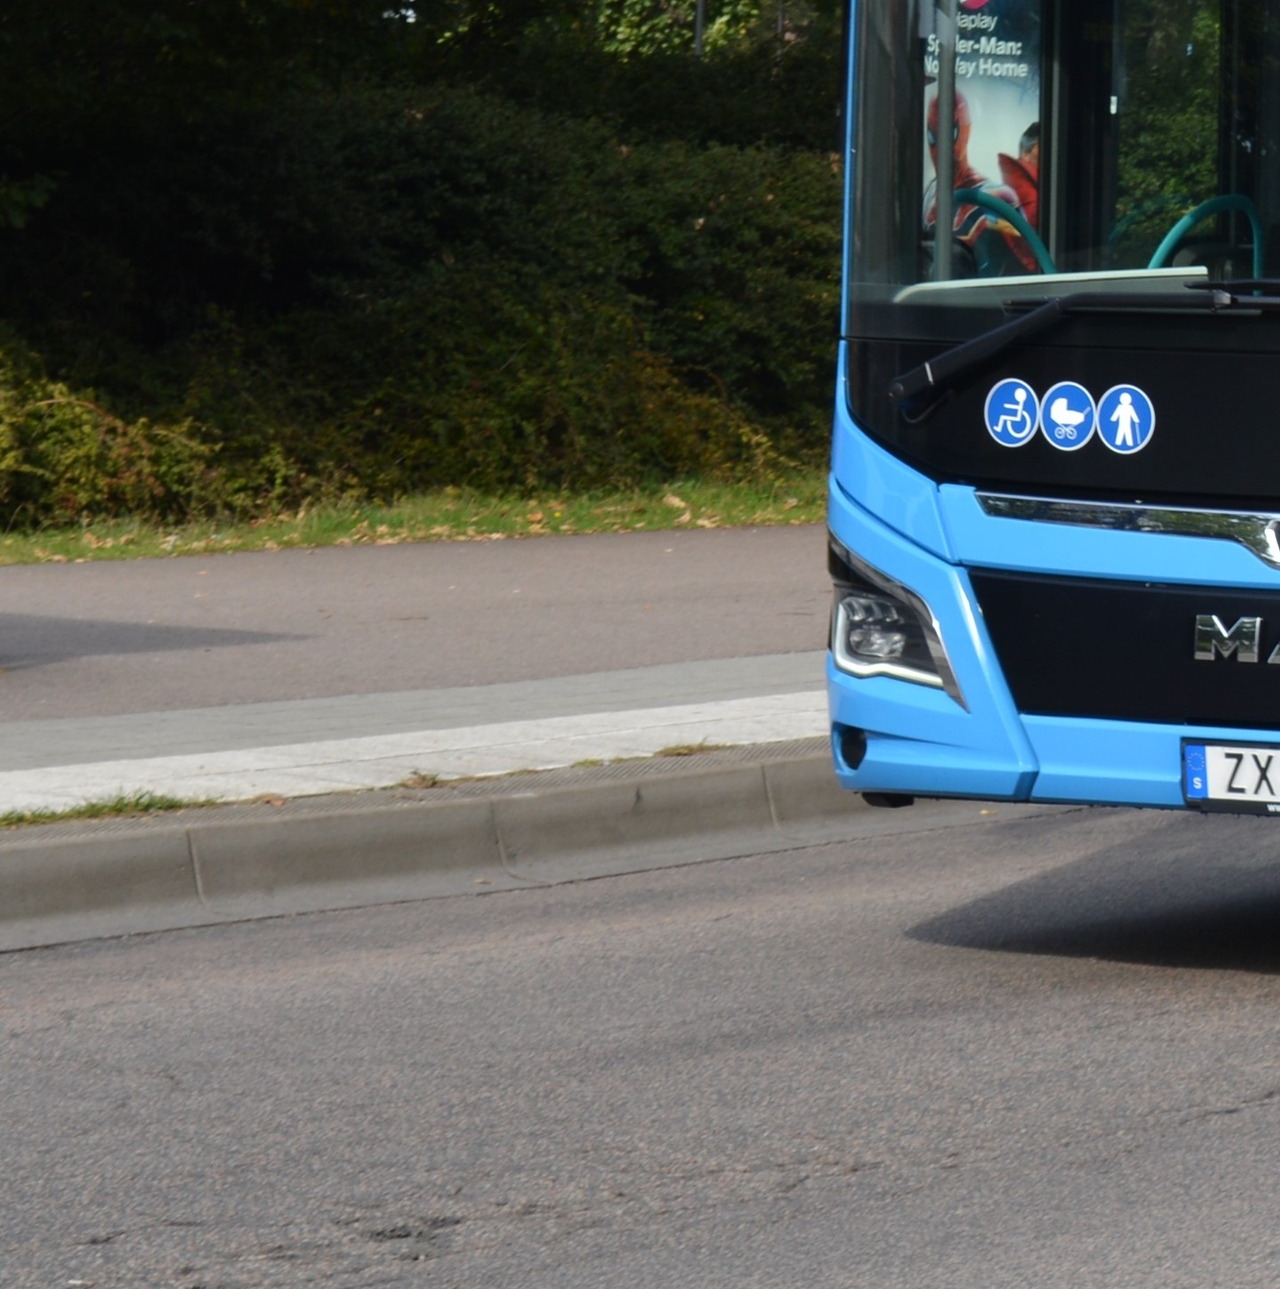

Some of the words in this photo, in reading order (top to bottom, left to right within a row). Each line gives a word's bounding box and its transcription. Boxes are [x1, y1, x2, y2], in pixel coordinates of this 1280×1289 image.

[957, 12, 998, 31] iaplay
[927, 34, 1022, 56] Sper-Man:
[980, 58, 1029, 77] Home
[1192, 777, 1202, 790] S
